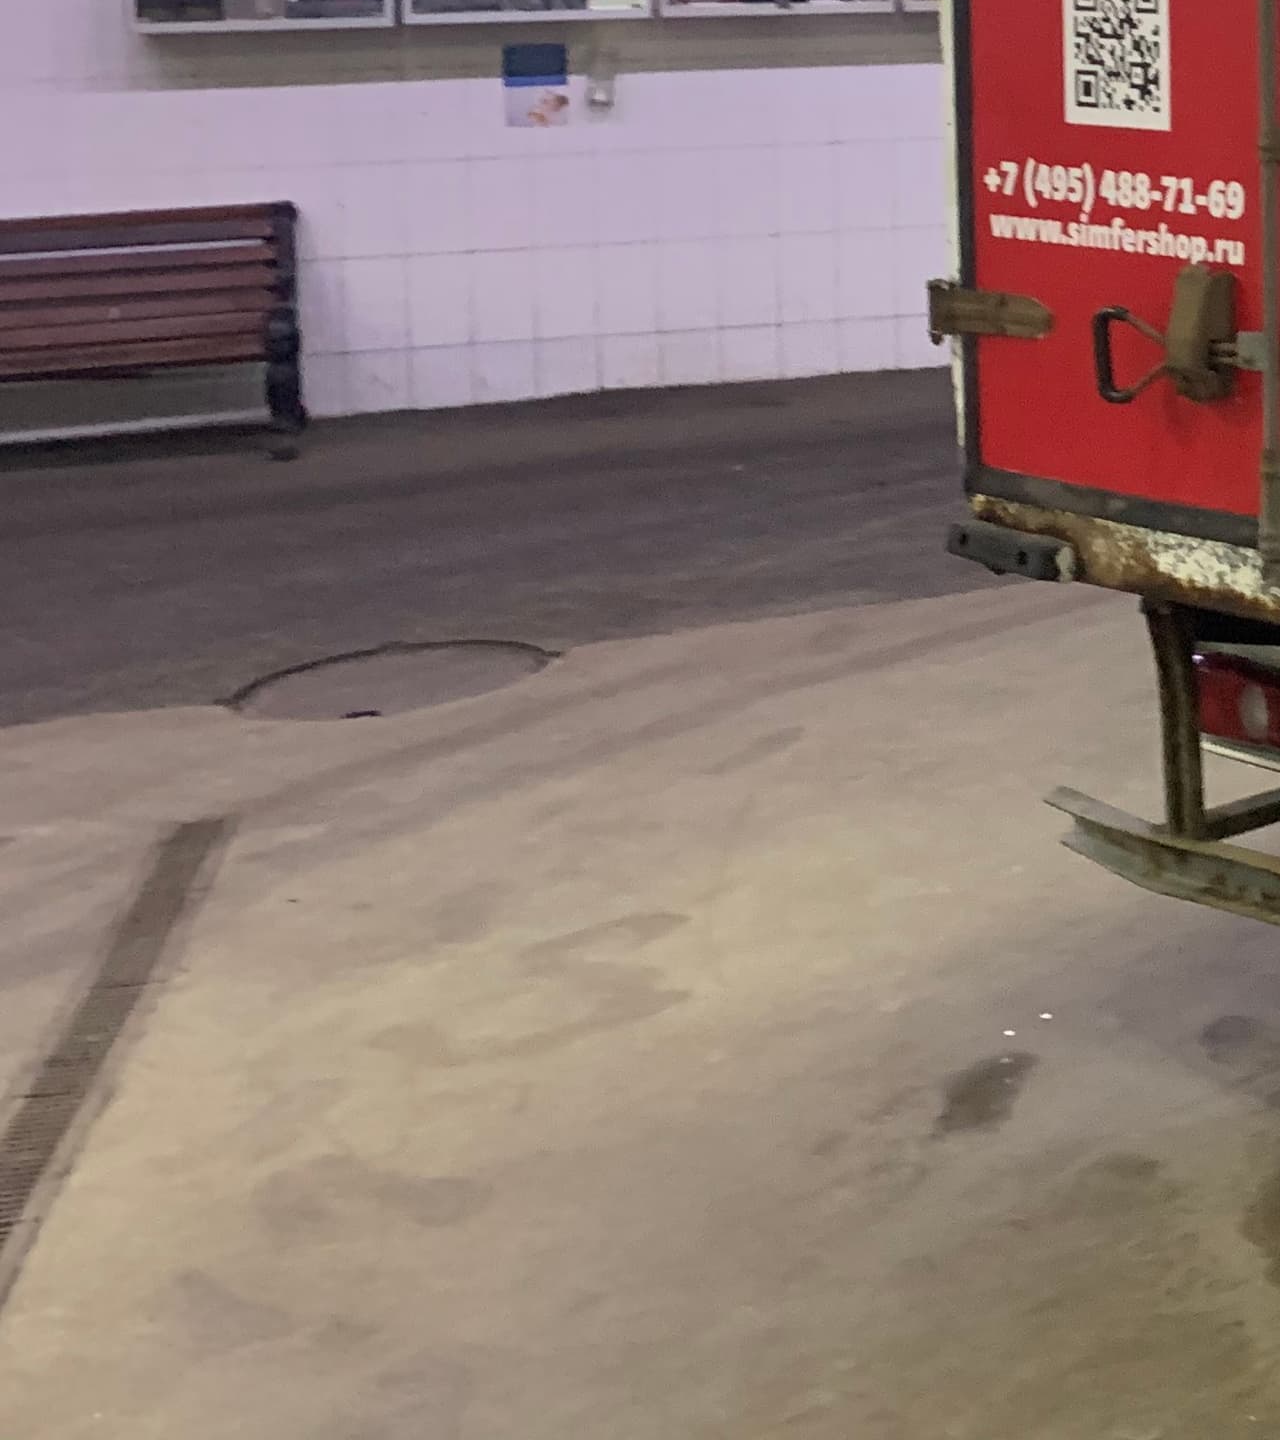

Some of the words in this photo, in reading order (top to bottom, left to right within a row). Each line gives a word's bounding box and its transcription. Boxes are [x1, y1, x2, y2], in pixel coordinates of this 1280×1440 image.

[983, 160, 1018, 196] +7
[1023, 157, 1096, 214] (495)
[1099, 169, 1246, 220] 488-71-69
[988, 212, 1246, 266] www.simfershop.ru
